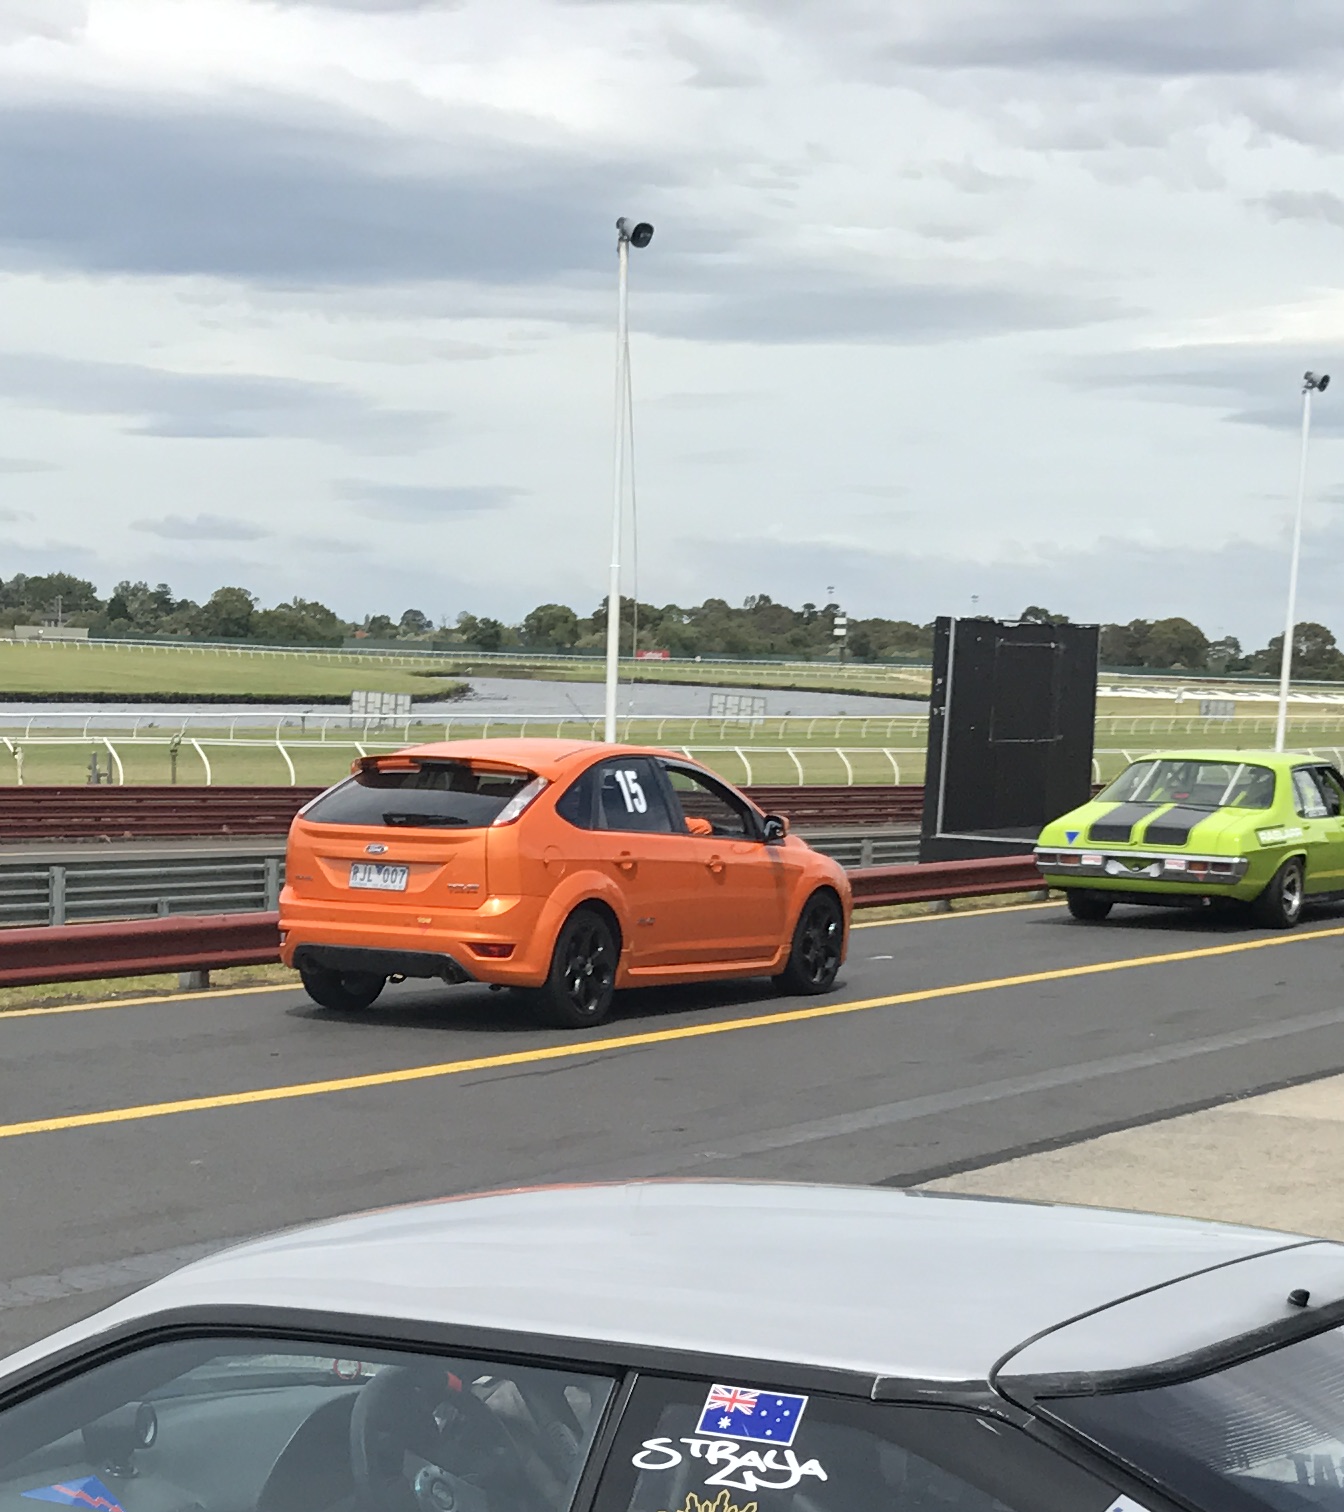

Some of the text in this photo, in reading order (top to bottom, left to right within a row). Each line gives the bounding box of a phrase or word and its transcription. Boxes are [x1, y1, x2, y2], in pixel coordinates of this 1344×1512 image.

[614, 769, 648, 814] 15
[382, 867, 406, 884] 007
[631, 1437, 828, 1492] STRAYA
